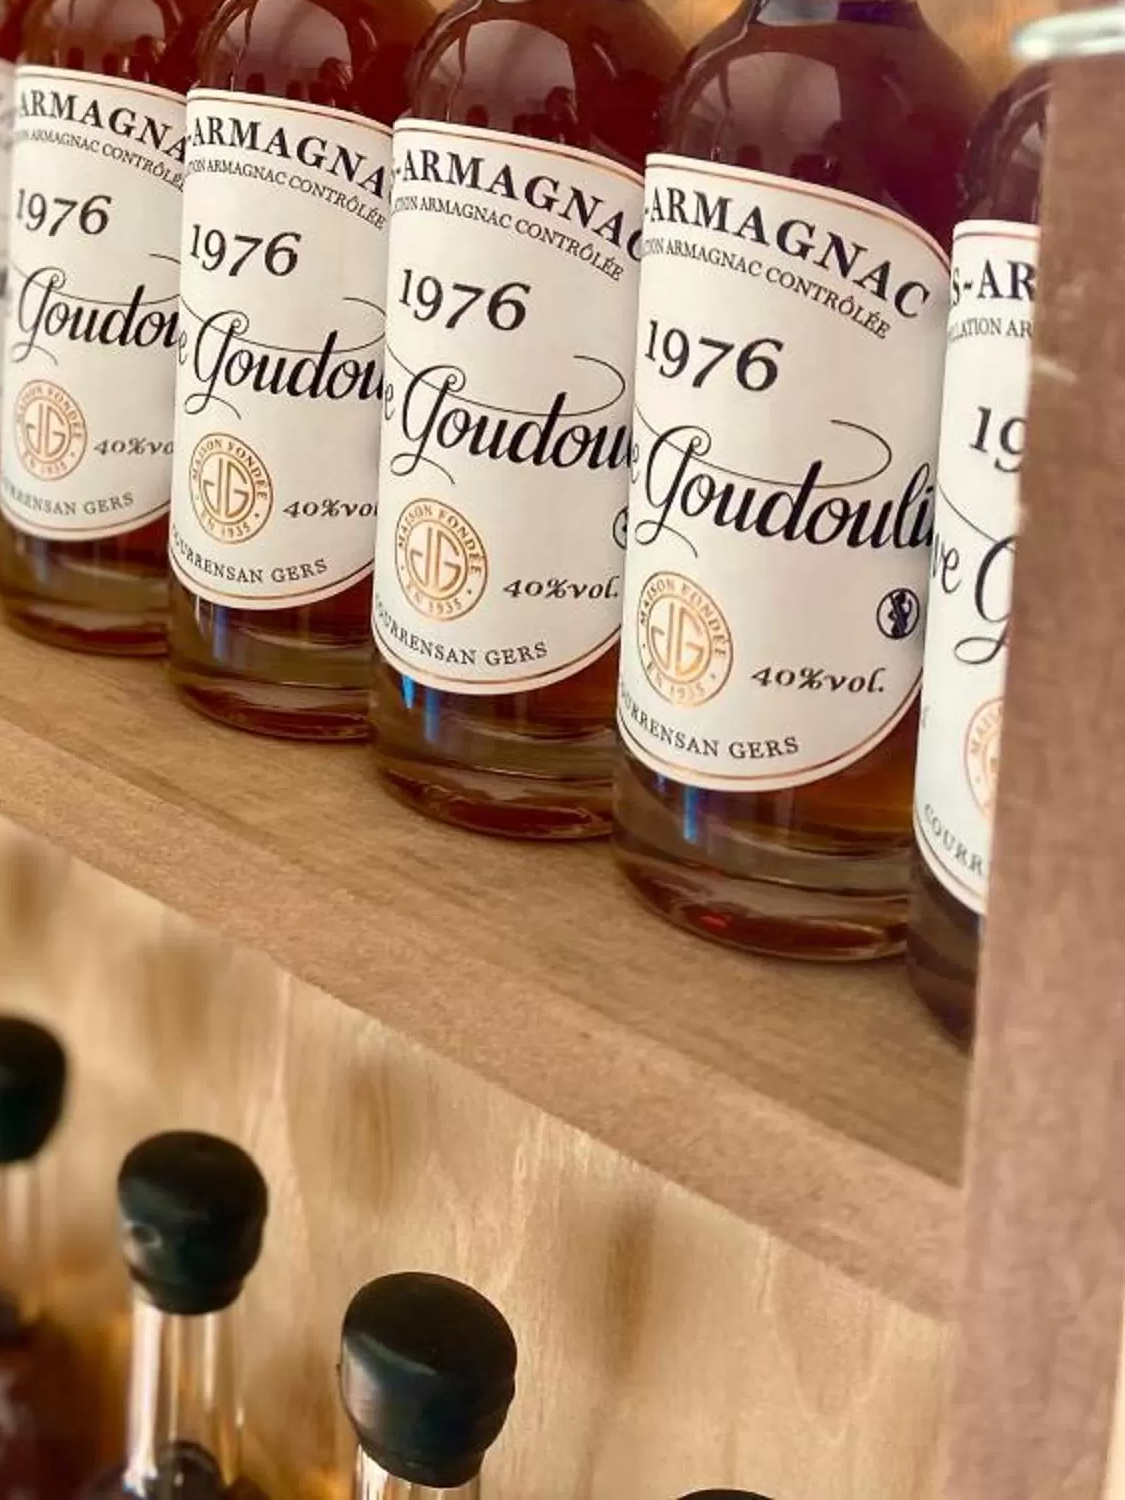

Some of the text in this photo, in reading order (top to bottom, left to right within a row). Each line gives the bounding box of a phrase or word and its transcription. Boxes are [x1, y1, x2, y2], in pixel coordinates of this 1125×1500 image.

[17, 188, 113, 238] 1976
[207, 159, 387, 231] ARMAGNAC CONTRÔLÉE
[189, 223, 303, 278] 1976
[419, 196, 625, 282] ARMAGNAC CONTRÔLÉE
[398, 268, 532, 332] 1976
[666, 238, 892, 341] ARMAGNAC CONTRÔLÉE
[644, 319, 785, 393] 1976
[83, 490, 135, 515] GERS
[271, 556, 328, 583] GERS
[502, 575, 621, 600] 40%vol.
[484, 640, 548, 667] GERS
[751, 666, 887, 693] 40%vol.
[728, 735, 800, 760] GERS
